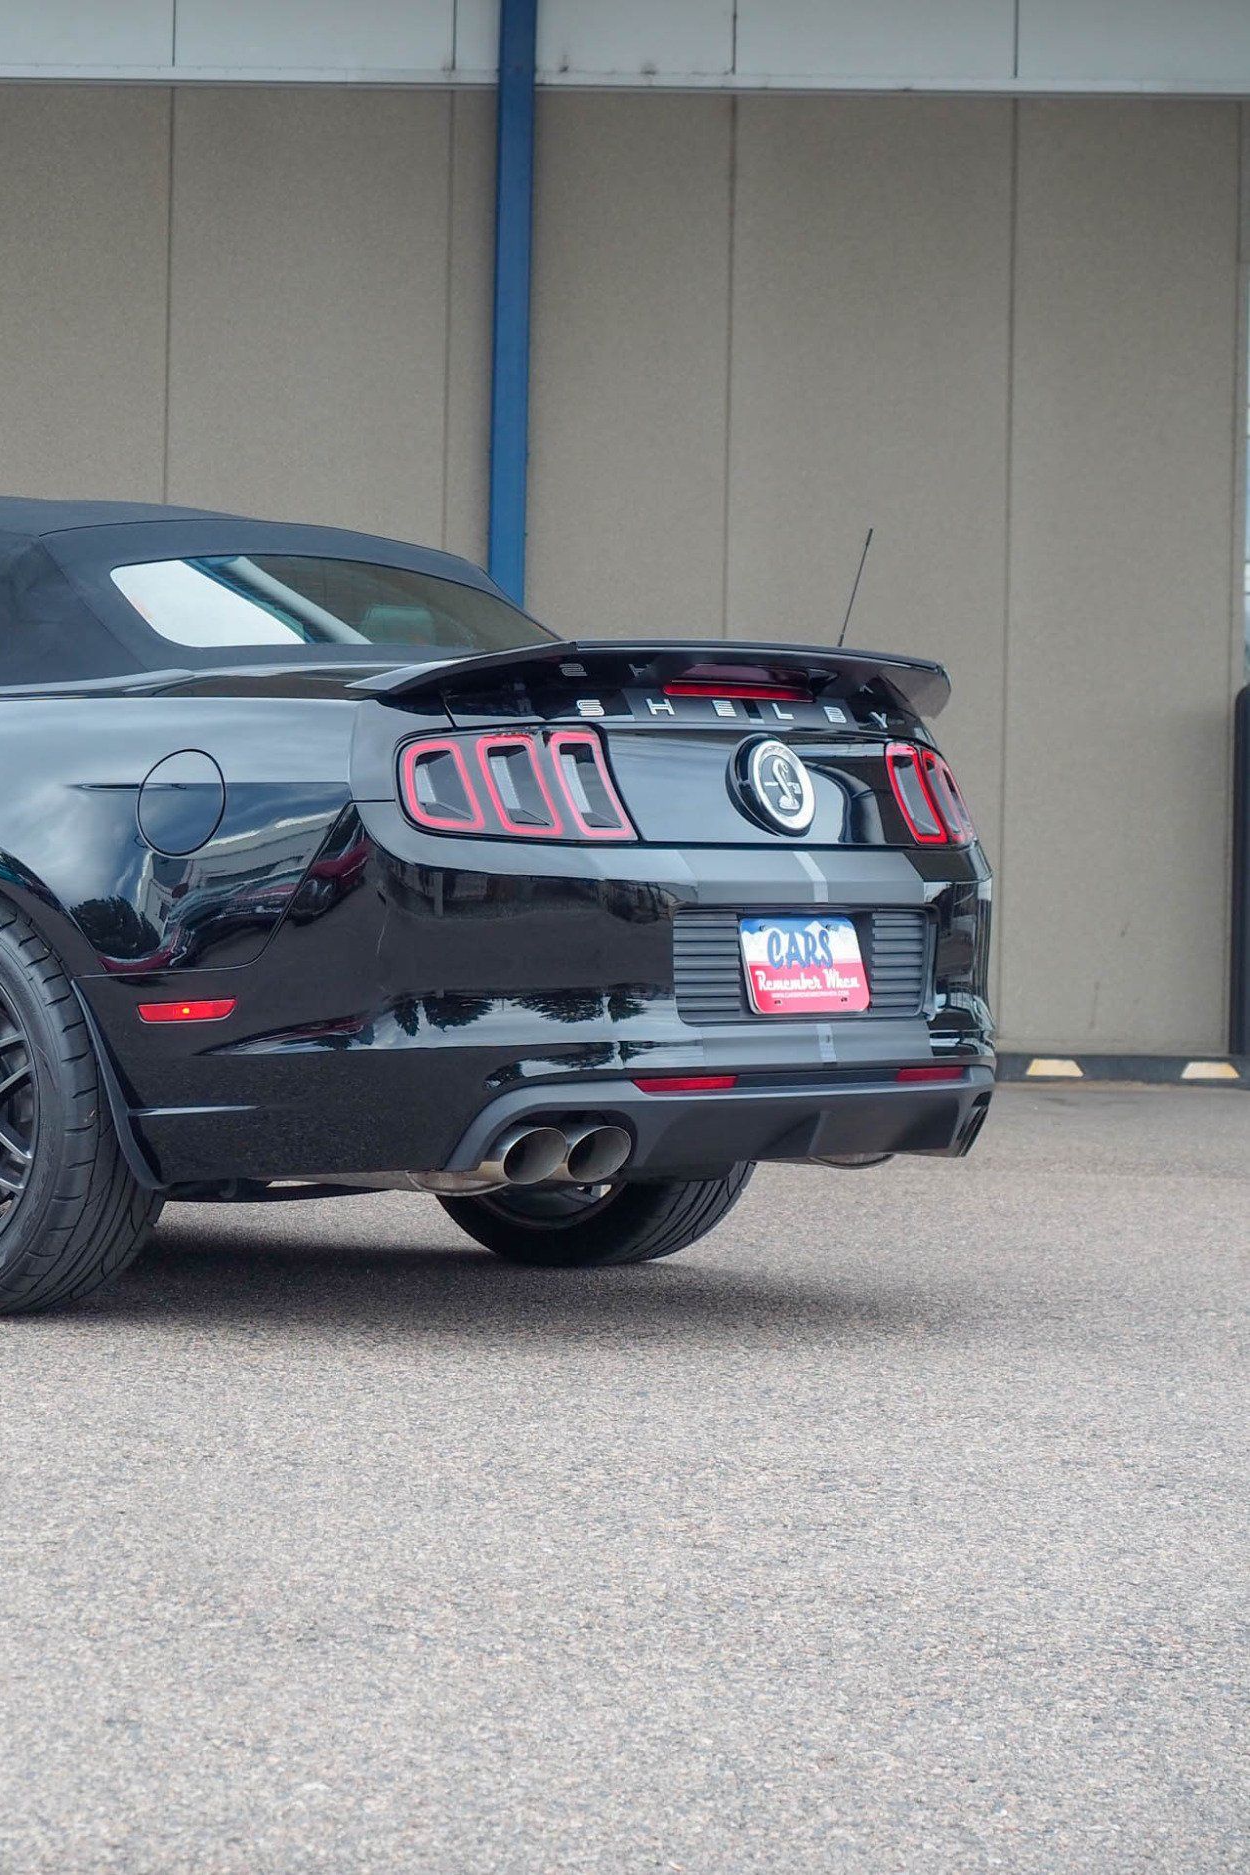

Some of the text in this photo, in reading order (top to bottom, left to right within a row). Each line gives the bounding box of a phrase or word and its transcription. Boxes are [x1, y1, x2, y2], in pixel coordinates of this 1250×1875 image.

[576, 698, 889, 729] SHELBY
[767, 930, 834, 970] CARS
[755, 969, 861, 991] Remember When
